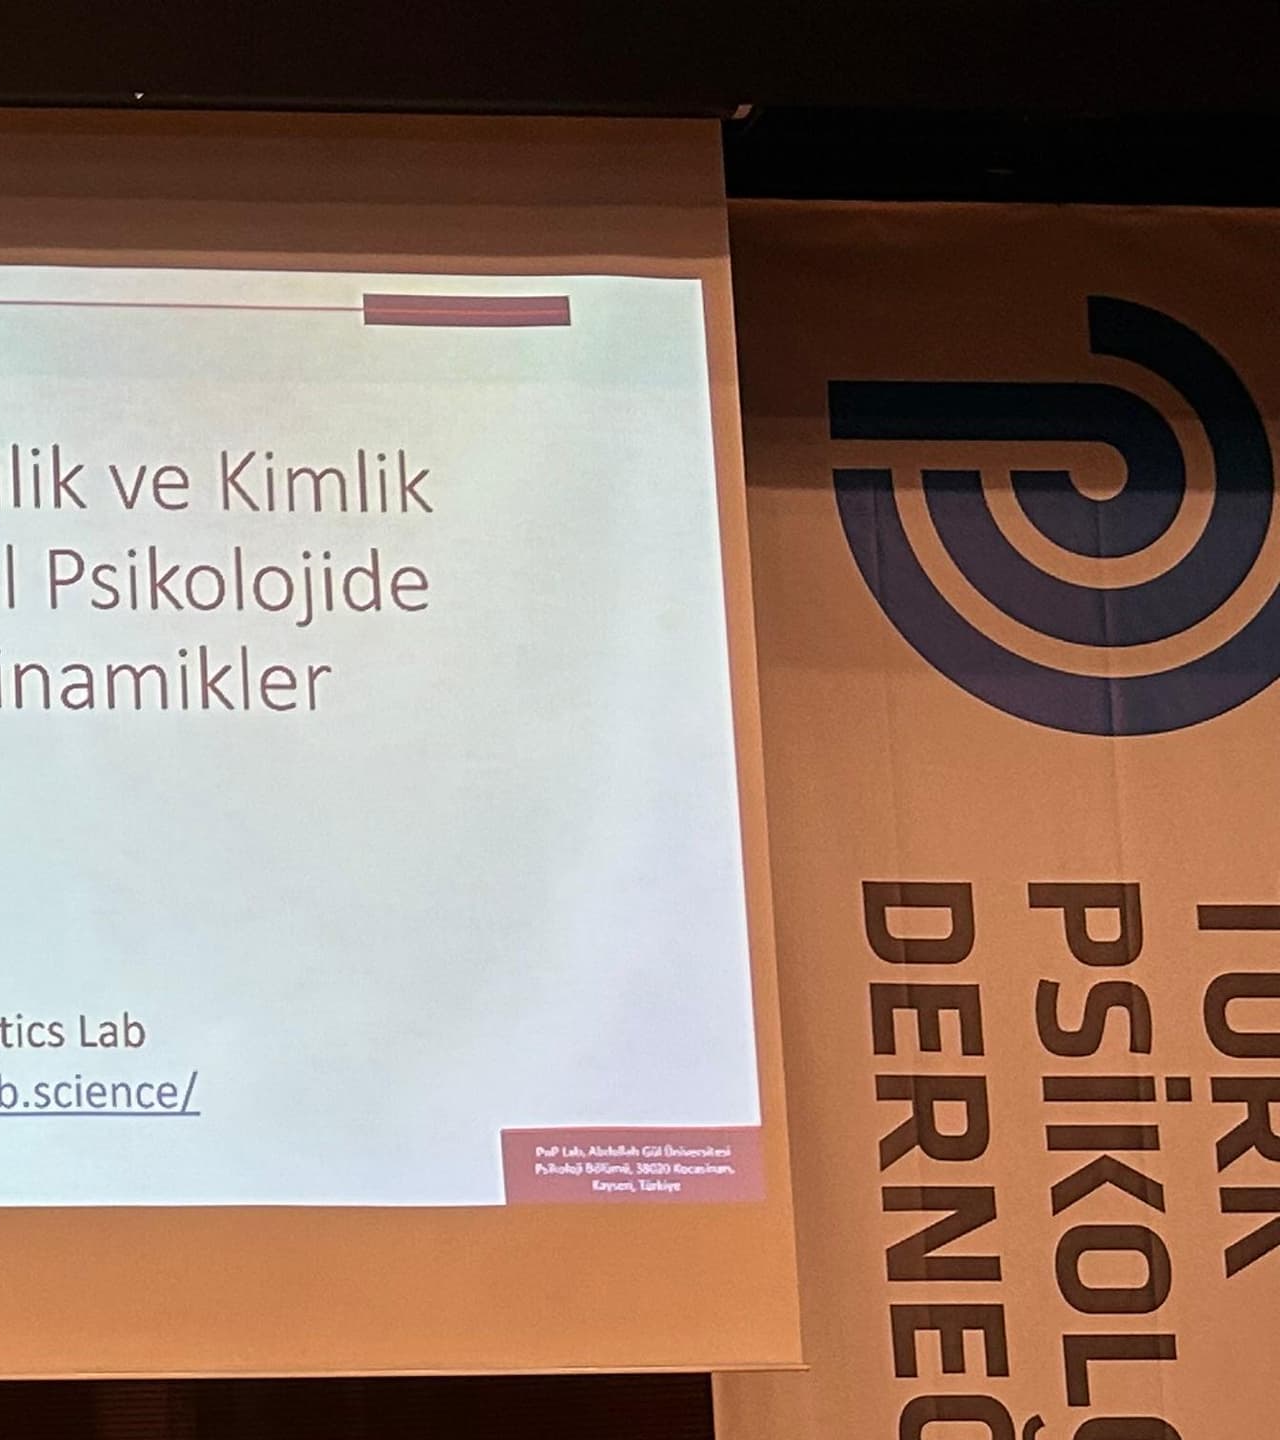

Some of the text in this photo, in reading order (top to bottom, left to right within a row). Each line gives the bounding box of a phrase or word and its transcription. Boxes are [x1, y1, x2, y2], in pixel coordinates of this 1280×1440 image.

[109, 463, 190, 510] ve
[221, 449, 433, 512] Kimlik
[49, 545, 429, 627] Psikolojide
[80, 1012, 146, 1050] Lab
